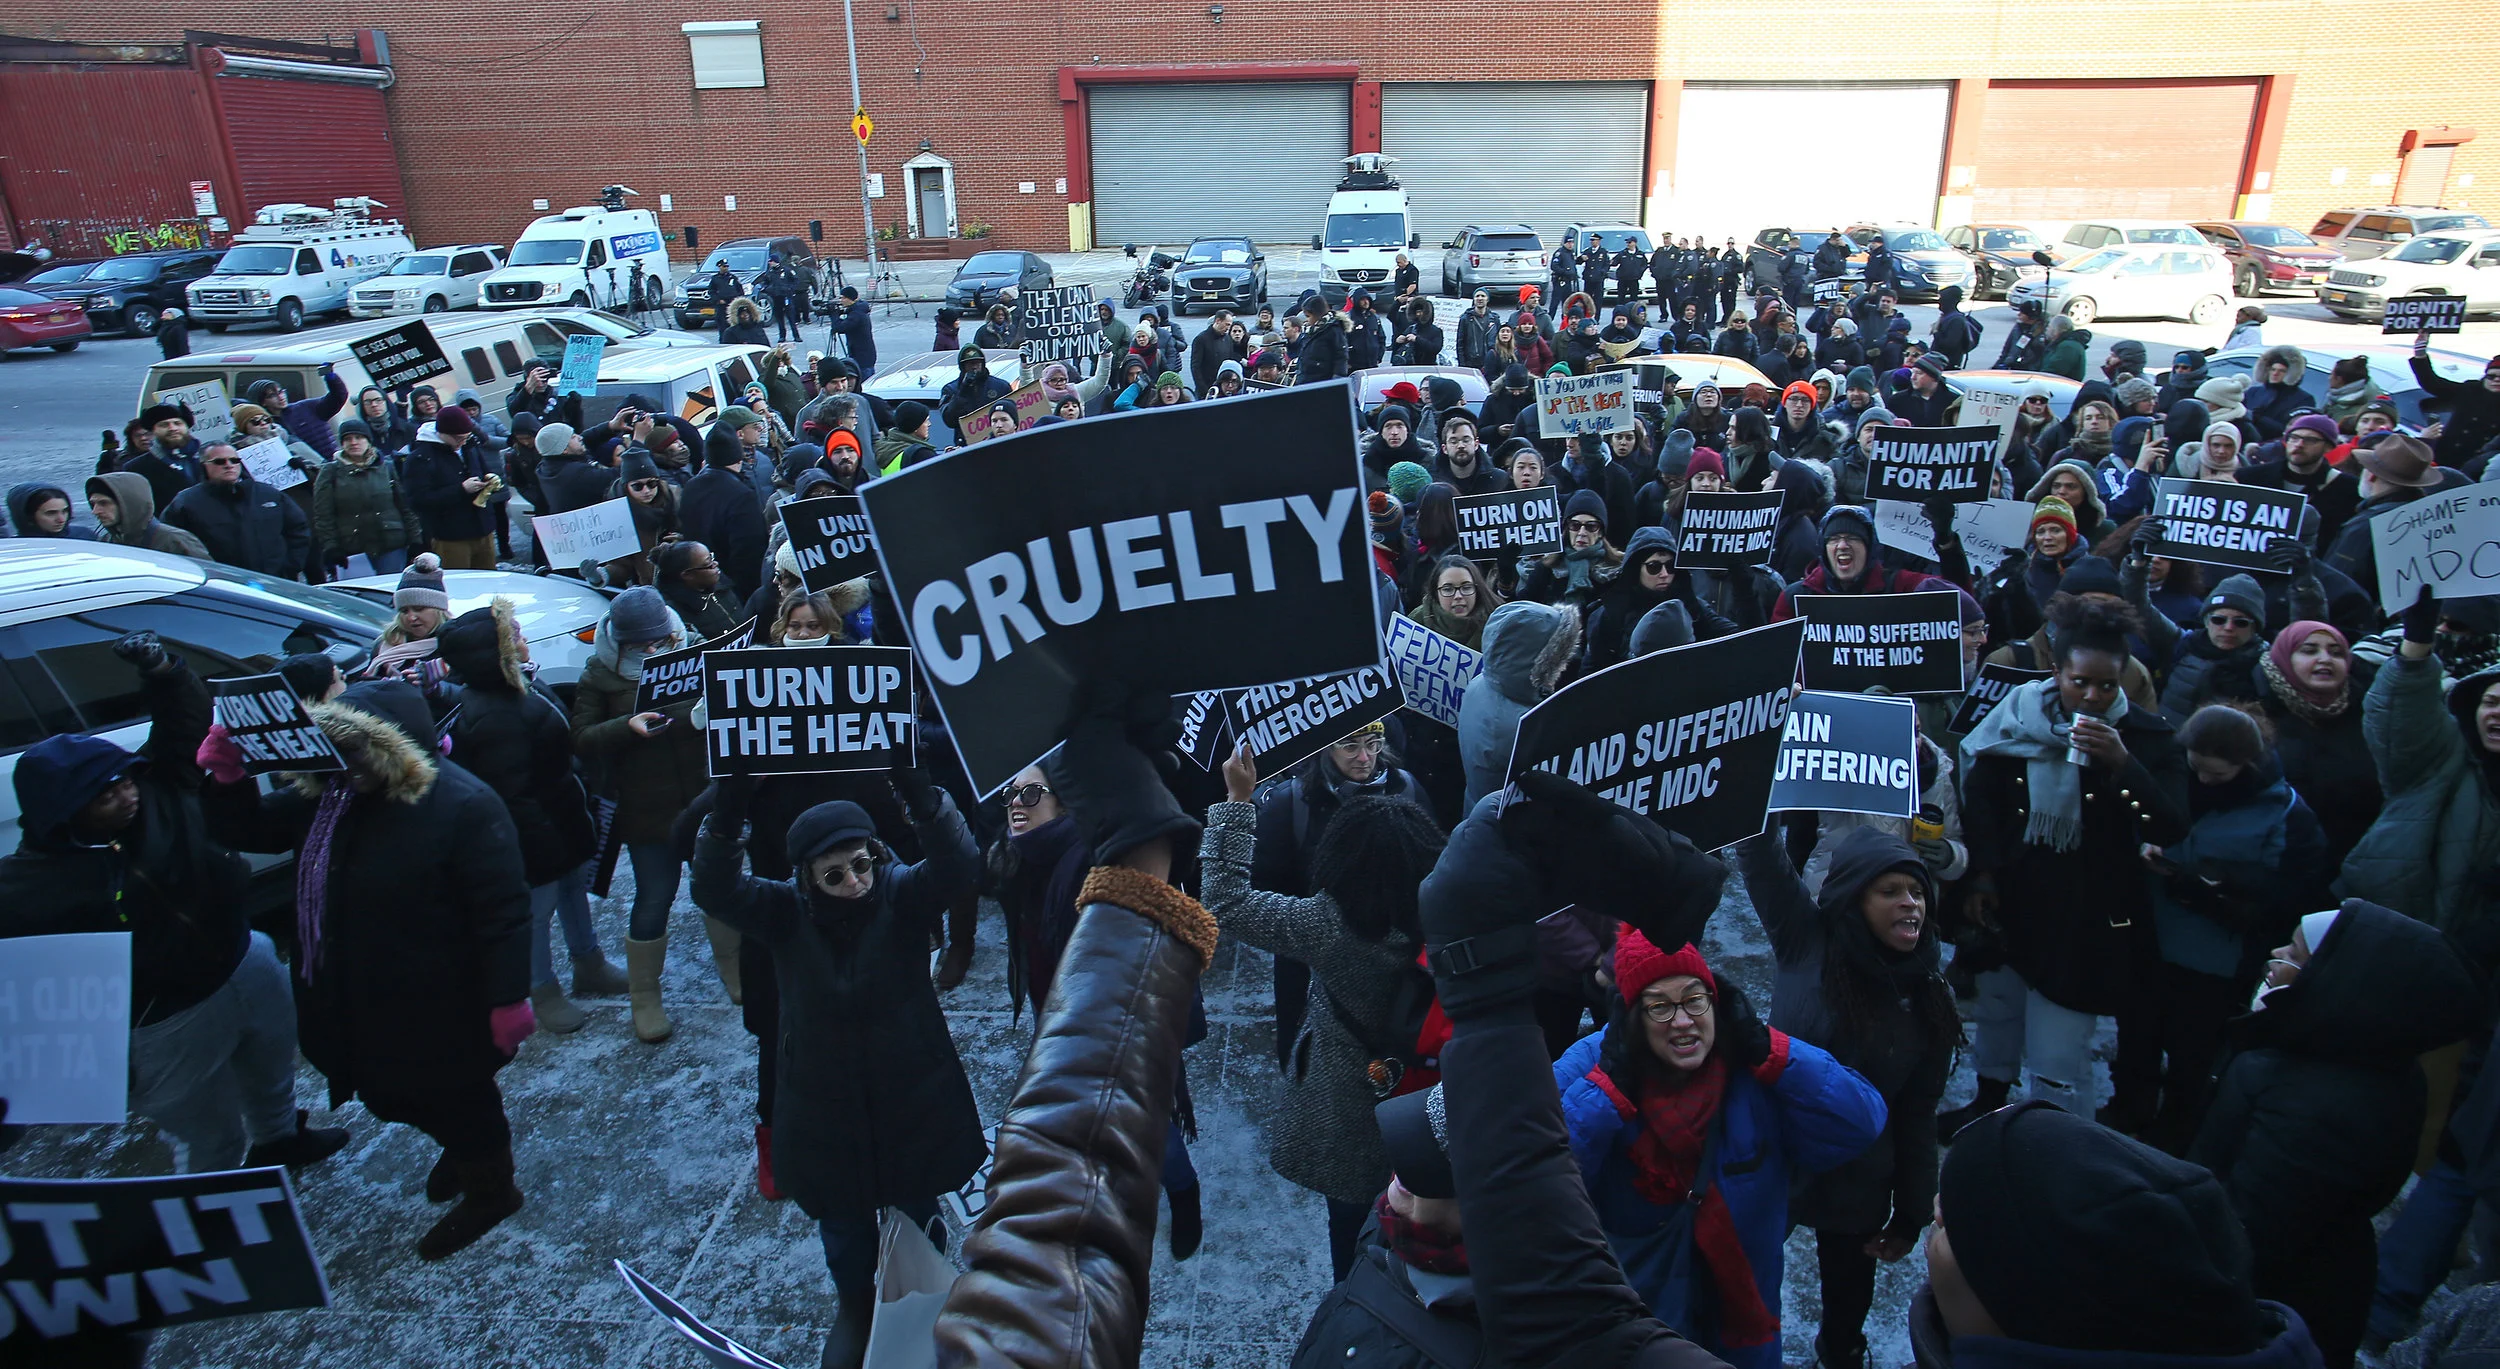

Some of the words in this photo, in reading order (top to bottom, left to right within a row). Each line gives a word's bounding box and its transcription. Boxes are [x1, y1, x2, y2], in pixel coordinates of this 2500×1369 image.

[331, 248, 346, 269] 4
[1022, 288, 1062, 309] THEY
[2385, 301, 2466, 315] DIGNITY
[1025, 302, 1101, 329] SILENCE
[2383, 316, 2421, 330] FOR
[2422, 316, 2461, 329] ALL
[369, 339, 389, 353] SEE
[384, 333, 407, 347] YOU.
[1047, 323, 1085, 337] OUR
[379, 353, 405, 369] HEAR
[402, 347, 424, 361] YOU.
[389, 367, 419, 385] STAND
[416, 363, 430, 376] BY
[427, 357, 450, 371] YOU.
[1538, 379, 1551, 396] IF
[1967, 388, 1991, 403] LET
[1993, 391, 2019, 407] THEM
[1563, 395, 1591, 415] THE
[1979, 404, 2003, 417] OUT
[1871, 440, 1999, 465] HUMANITY
[1881, 466, 1933, 491] FOR
[1937, 467, 1978, 491] ALL
[817, 514, 869, 537] UNI
[1458, 502, 1517, 528] TURN
[1522, 498, 1553, 522] ON
[1681, 506, 1782, 530] INHUMANITY
[2165, 494, 2217, 520] THIS
[2221, 499, 2248, 524] IS
[2250, 503, 2291, 530] AN
[2386, 496, 2470, 546] SHAME
[1458, 528, 1501, 551] THE
[1505, 521, 1559, 546] HEAT
[1680, 532, 1708, 552] AT
[1711, 533, 1746, 554] THE
[1745, 529, 1772, 552] MDC
[2157, 518, 2297, 554] MERGENC
[2421, 523, 2457, 553] you
[796, 544, 827, 571] IN
[830, 533, 873, 559] OU
[2396, 540, 2500, 598] MDC
[911, 486, 1358, 687] CRUELTY
[1835, 624, 1866, 644] AND
[1869, 620, 1959, 644] SUFFERING
[1388, 617, 1484, 686] FEDER
[1832, 647, 1850, 666] AT
[1853, 647, 1885, 667] THE
[1889, 646, 1924, 667] MDC
[652, 675, 701, 700] FOR
[716, 666, 834, 709] TURN
[847, 665, 901, 705] UP
[258, 689, 298, 723] UP
[709, 717, 795, 758] THE
[807, 712, 912, 755] HEAT
[1566, 732, 1626, 786] AND
[1632, 687, 1790, 768] SUFFERING
[1782, 711, 1832, 743] AIN
[263, 726, 336, 760] HEAT
[1774, 748, 1910, 790] UFFERING
[1657, 756, 1722, 812] MDC
[152, 1186, 286, 1257] IT
